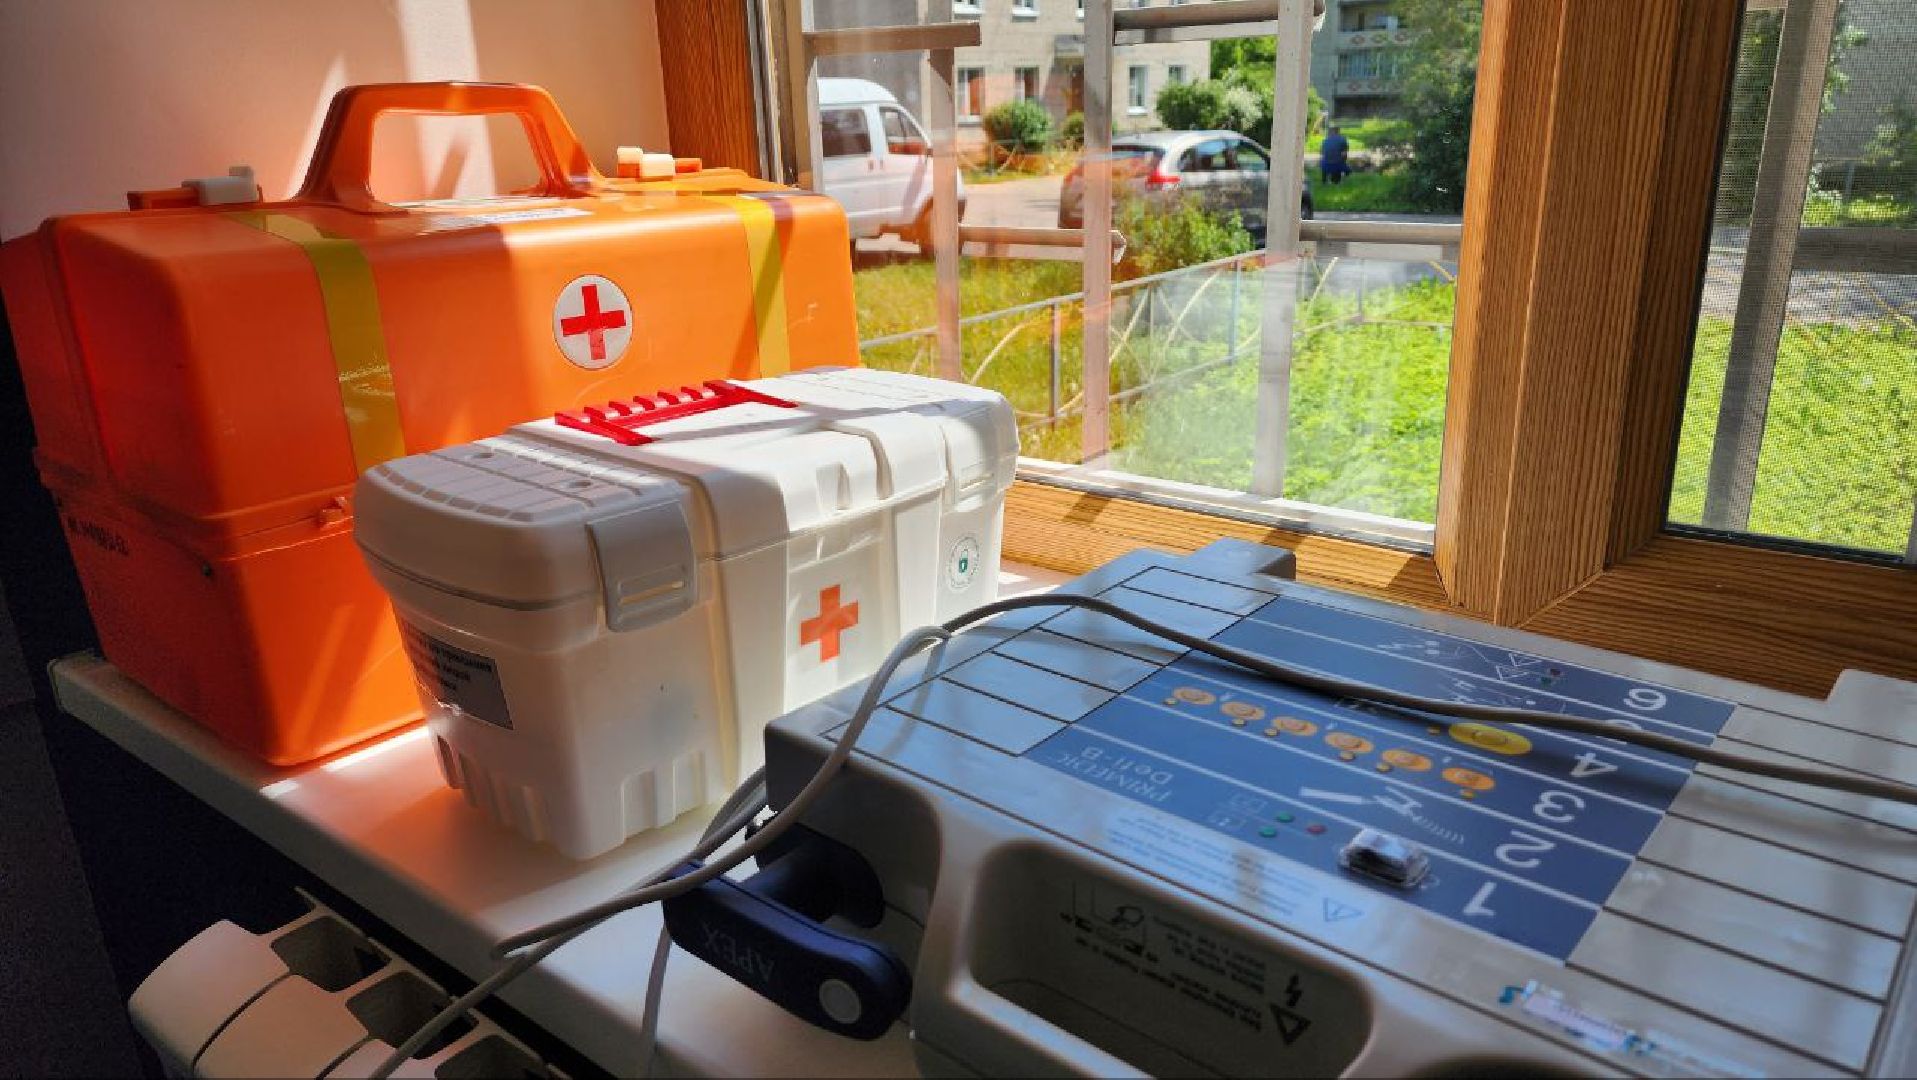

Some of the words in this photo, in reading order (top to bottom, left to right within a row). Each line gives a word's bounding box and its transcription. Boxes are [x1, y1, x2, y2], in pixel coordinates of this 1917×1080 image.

[1623, 688, 1667, 711] 6
[1570, 752, 1618, 778] 4
[1533, 790, 1586, 823] 3
[1495, 830, 1556, 868] 2
[1463, 882, 1497, 916] 1
[704, 922, 776, 982] APEX
